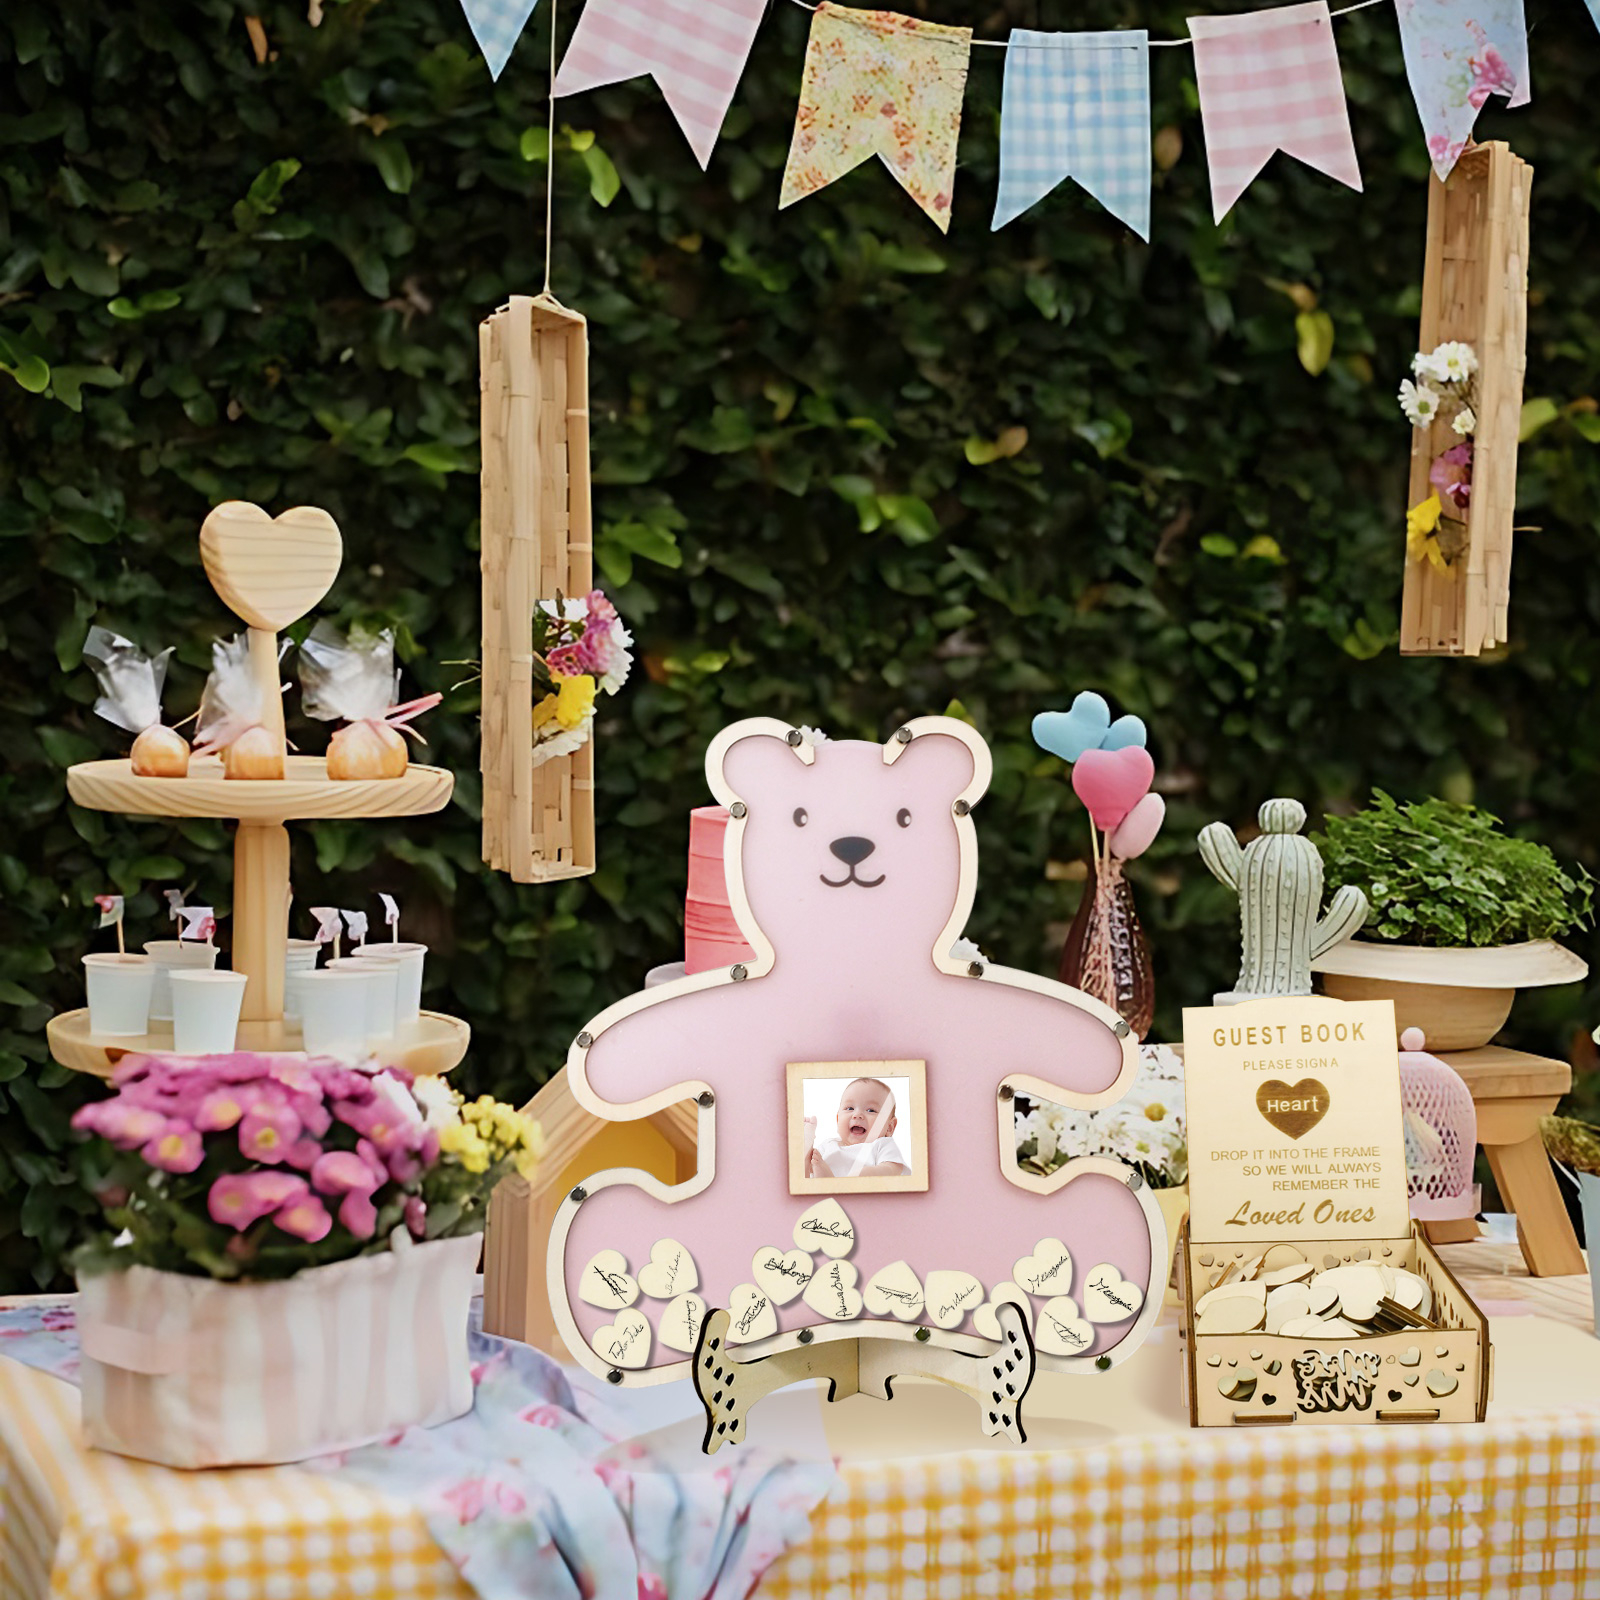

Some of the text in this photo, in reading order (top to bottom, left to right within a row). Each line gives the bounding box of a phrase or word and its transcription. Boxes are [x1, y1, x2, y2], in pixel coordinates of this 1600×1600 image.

[1212, 1022, 1366, 1047] GUEST BOOK
[1242, 1057, 1339, 1071] PLEASE SIGN A
[1266, 1095, 1320, 1114] Heart
[1210, 1146, 1381, 1161] DROP IT INTO THE FRAME
[1242, 1162, 1382, 1176] SO WE WILL ALWAYS
[1272, 1178, 1381, 1191] REMEMBER THE
[1224, 1199, 1377, 1226] Loved Ones
